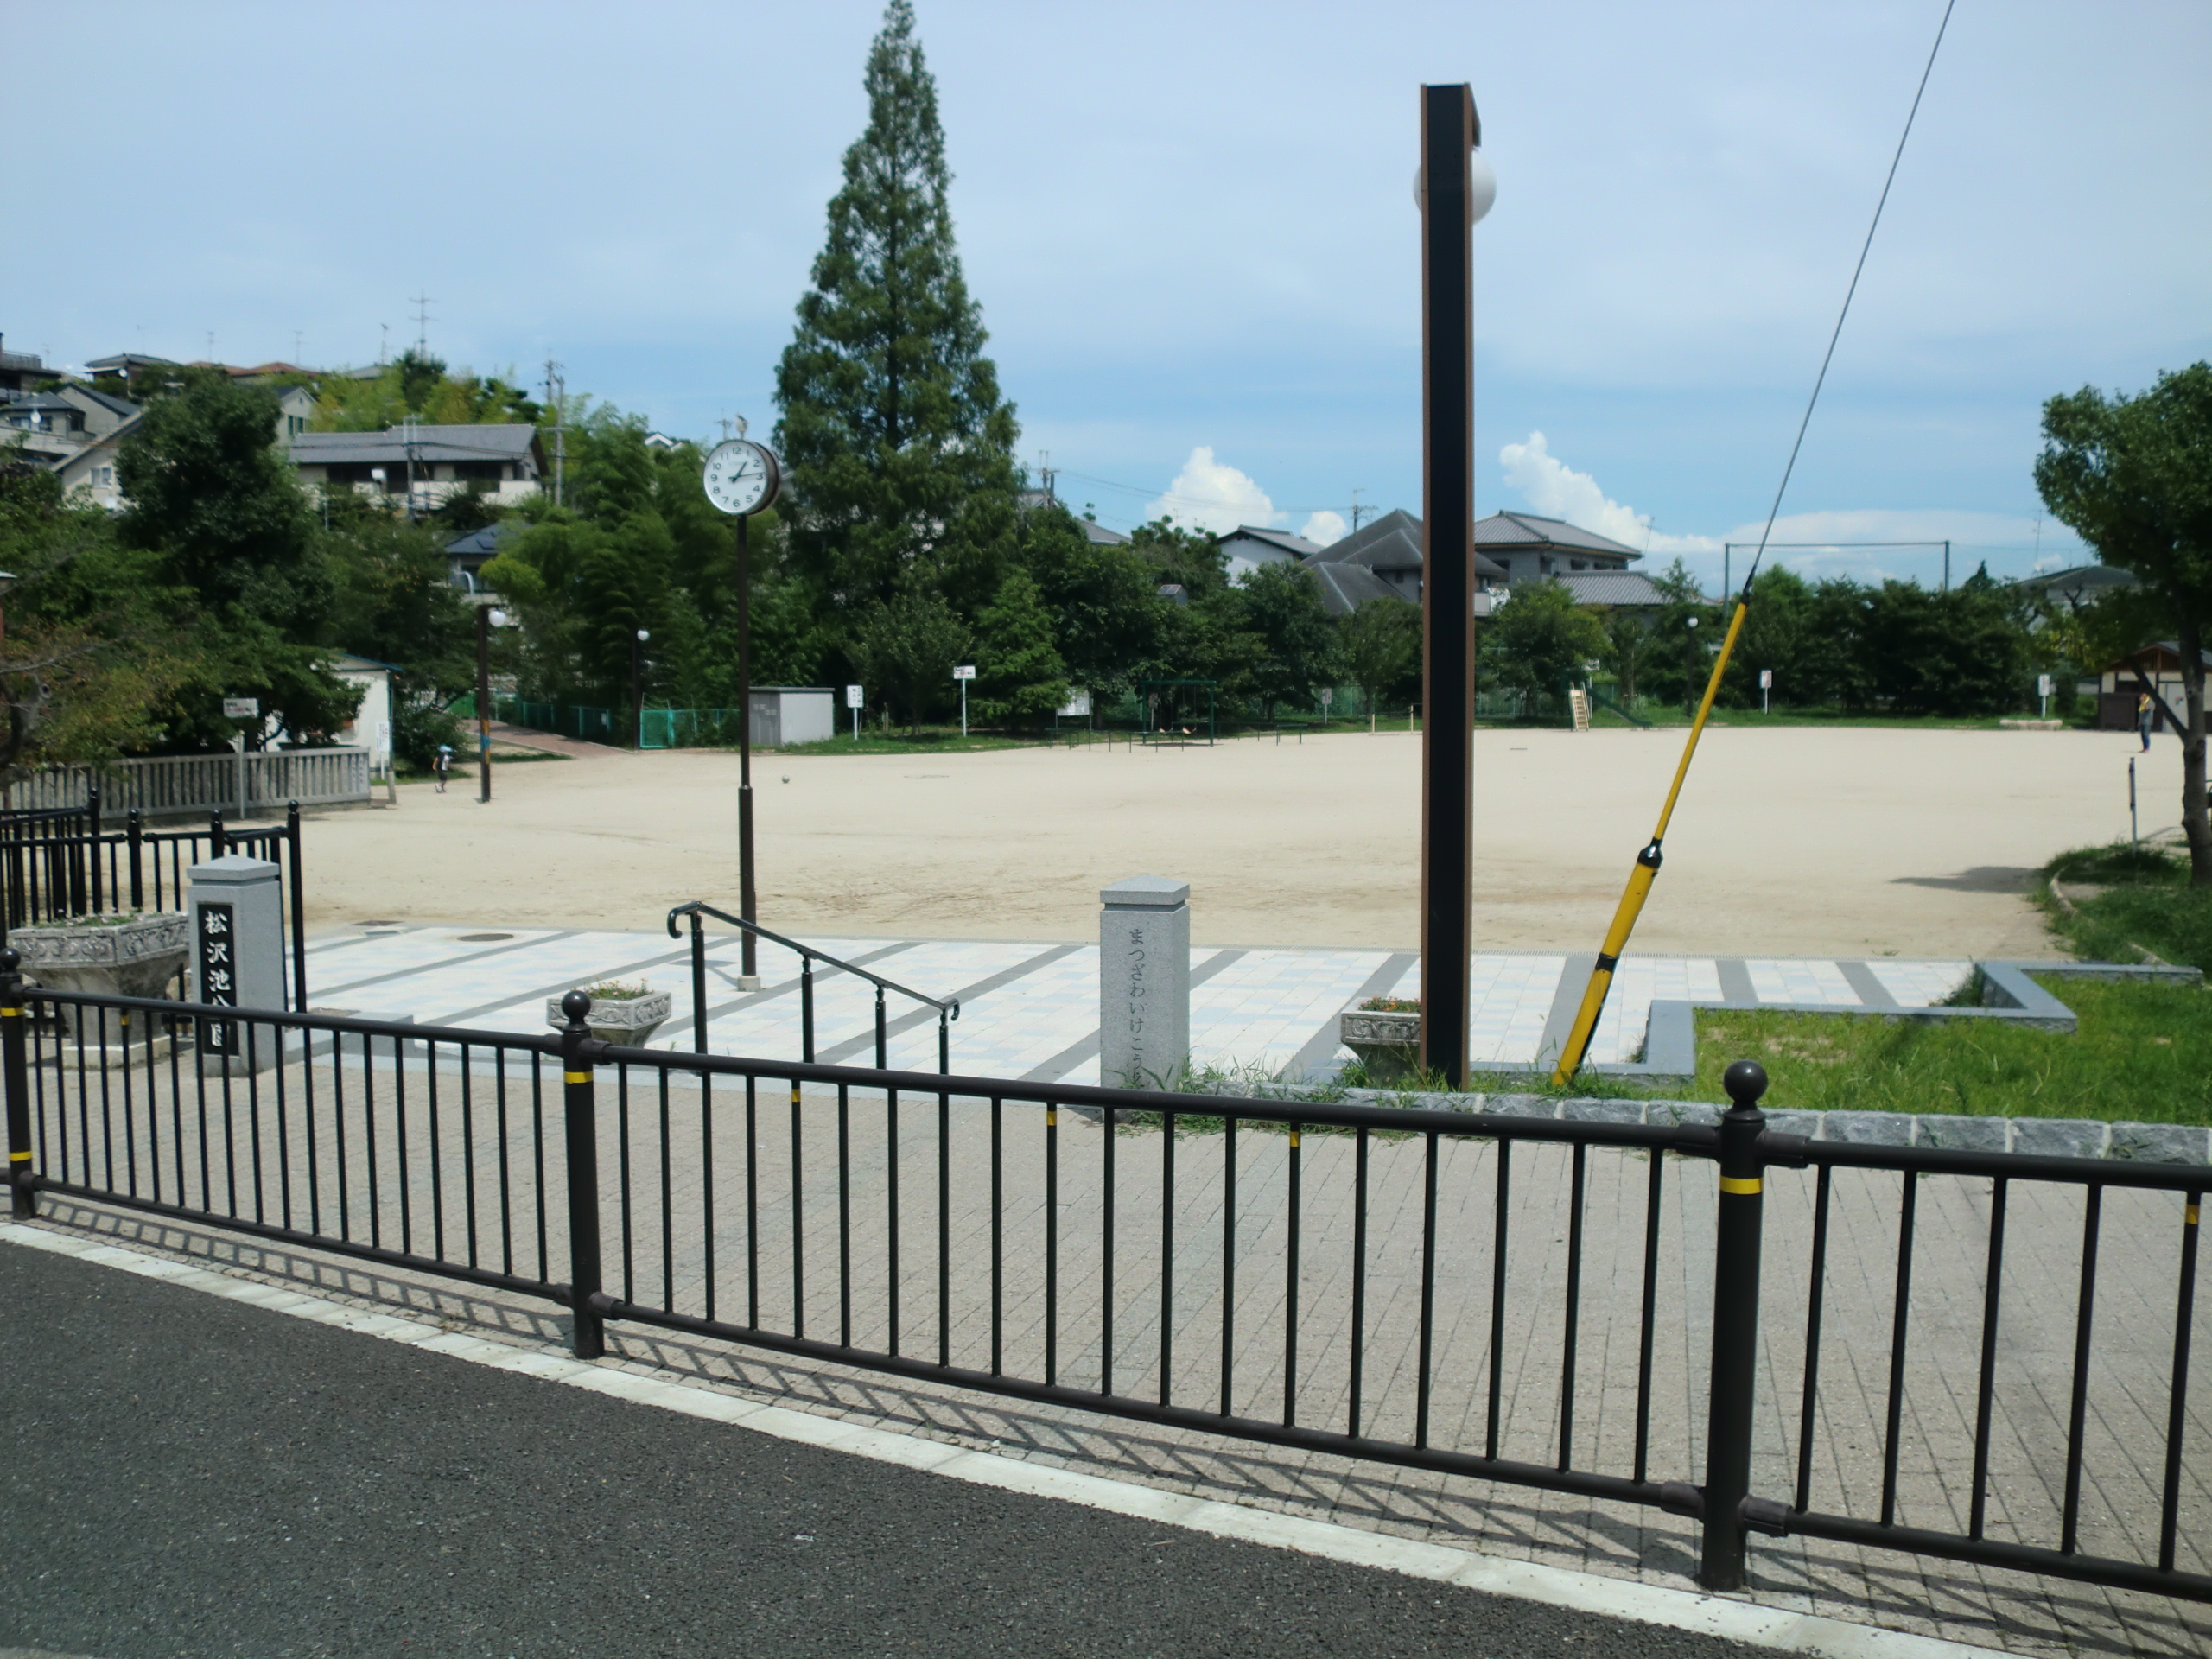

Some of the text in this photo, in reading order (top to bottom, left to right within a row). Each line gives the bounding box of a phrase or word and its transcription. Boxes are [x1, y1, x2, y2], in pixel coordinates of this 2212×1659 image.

[732, 447, 741, 455] 12
[712, 462, 722, 471] 10
[753, 459, 760, 467] 2
[709, 474, 718, 482] 9
[755, 472, 764, 480] 3
[712, 486, 721, 494] 8
[745, 494, 753, 503] 5
